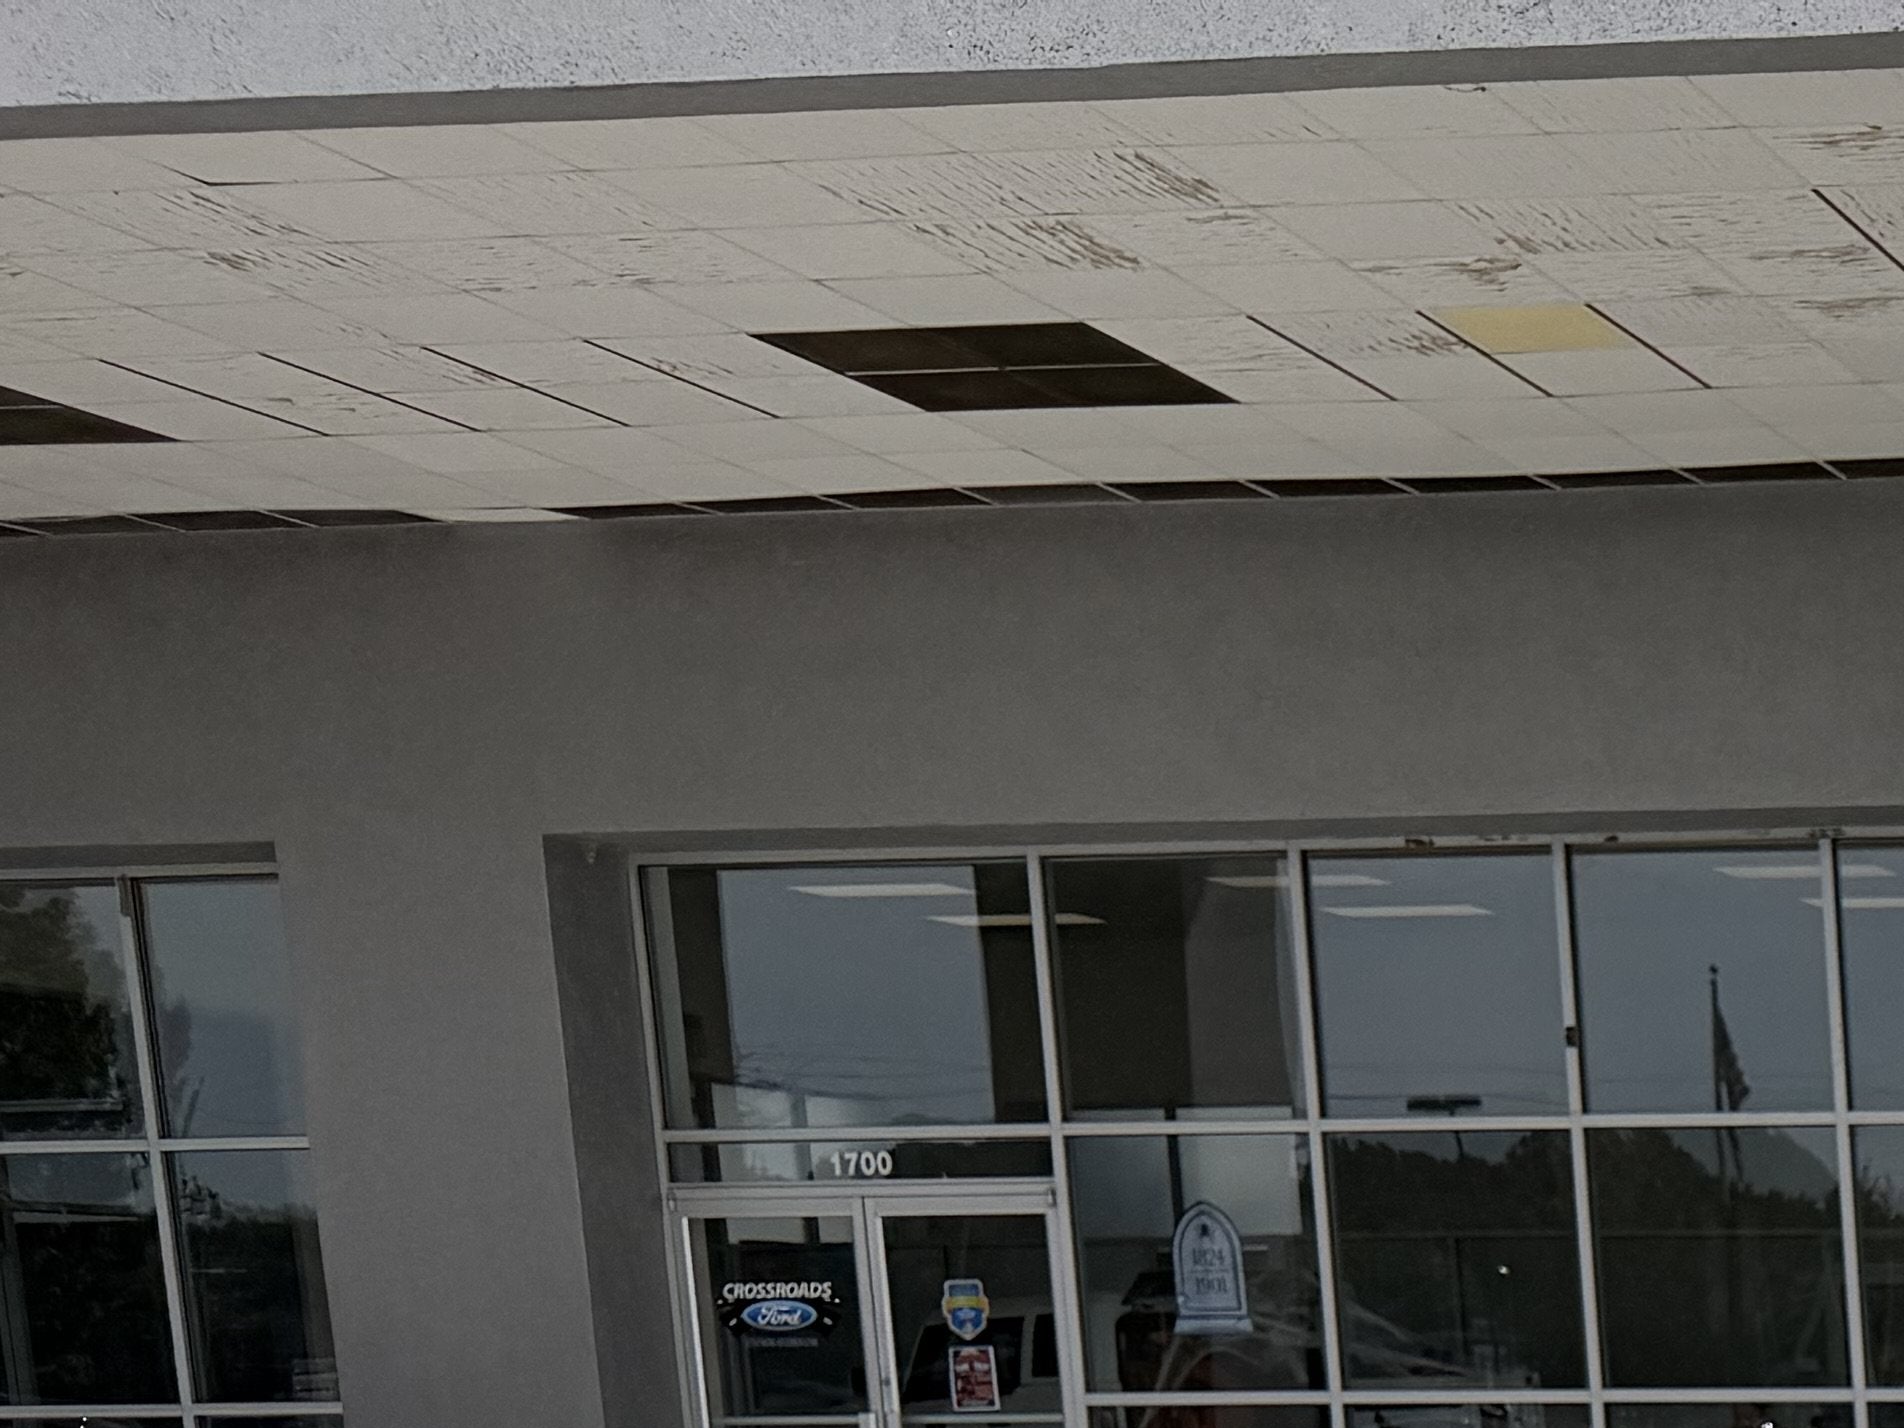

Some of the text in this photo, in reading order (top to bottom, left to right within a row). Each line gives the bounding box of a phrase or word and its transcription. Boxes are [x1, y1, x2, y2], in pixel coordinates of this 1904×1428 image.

[830, 1150, 893, 1177] 1700
[722, 1281, 832, 1301] CROSSROADS
[757, 1304, 801, 1325] Ford
